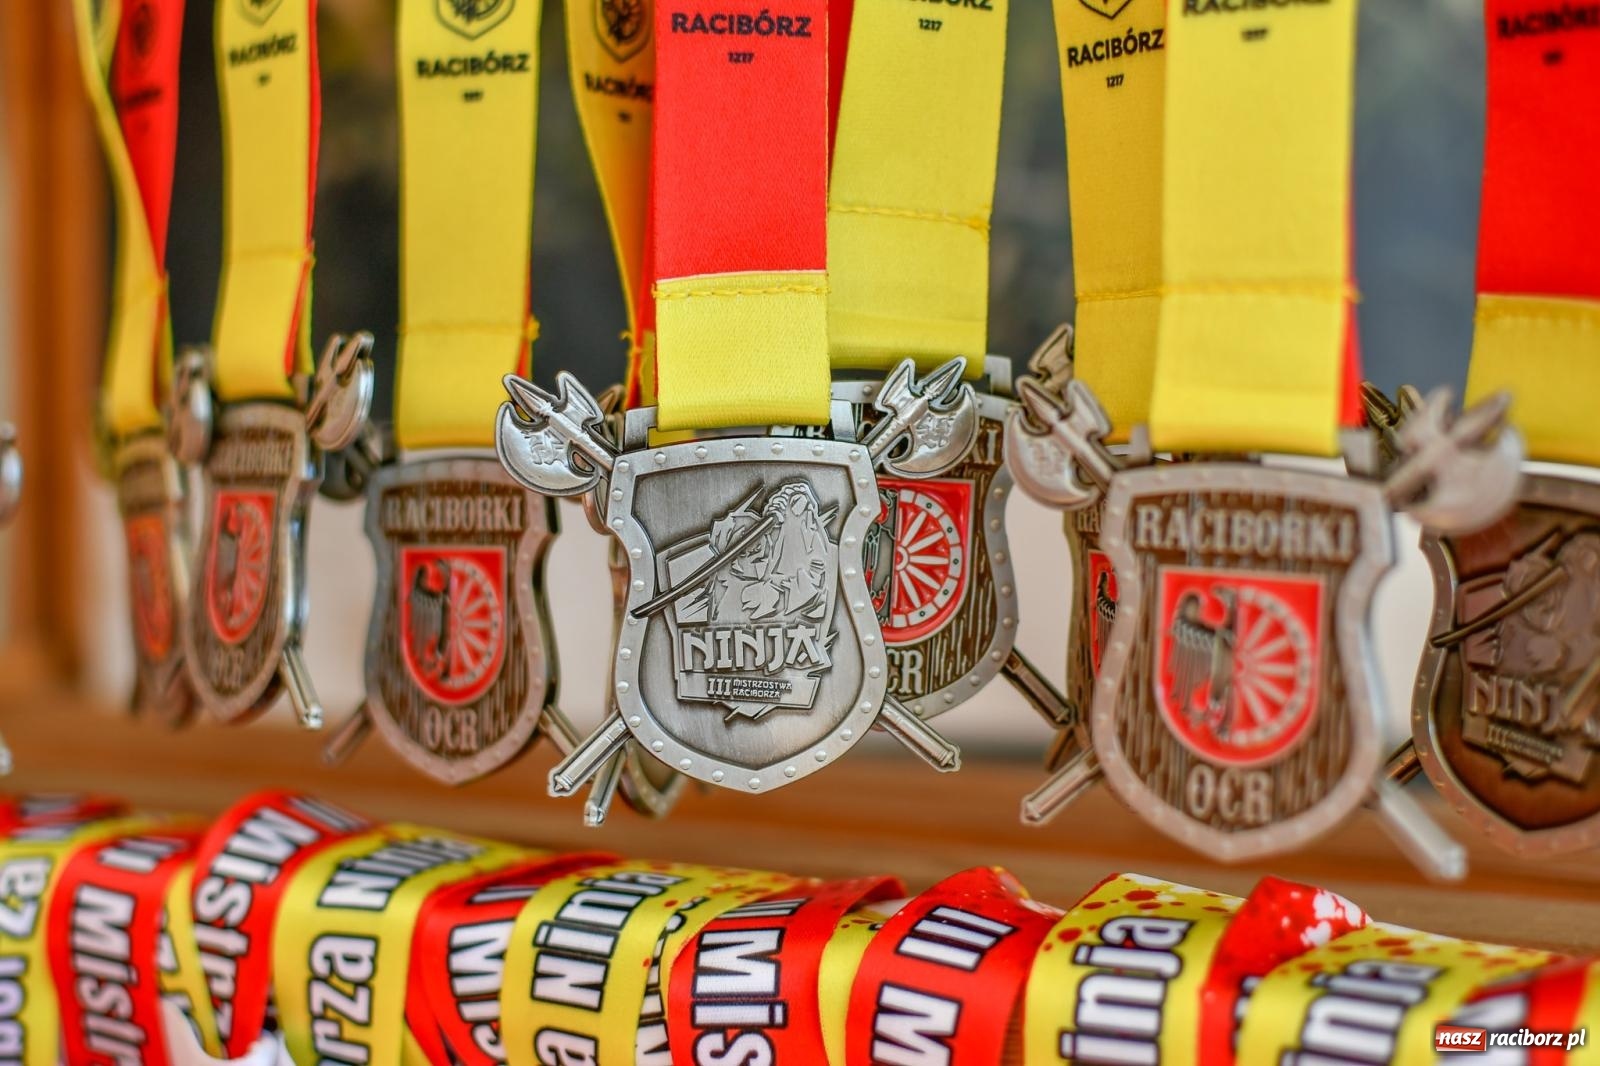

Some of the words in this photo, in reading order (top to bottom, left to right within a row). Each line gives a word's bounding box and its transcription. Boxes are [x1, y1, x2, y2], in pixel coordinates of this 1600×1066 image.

[672, 11, 812, 38] RACIBÓRZ
[918, 18, 943, 32] 1217
[1066, 28, 1165, 68] RACIBÓRZ
[416, 53, 531, 78] RACIBÓRZ
[385, 496, 524, 533] RACIBORKI
[1136, 503, 1356, 563] RACIBORKI
[682, 624, 821, 674] NINJA
[886, 648, 924, 695] CR
[732, 688, 780, 698] RACIBORZA
[1468, 671, 1564, 733] NINJ
[424, 706, 478, 751] OCR
[1187, 765, 1273, 822] OCR
[532, 869, 686, 1012] Ninja
[894, 904, 1019, 972] III
[309, 932, 380, 1066] rza
